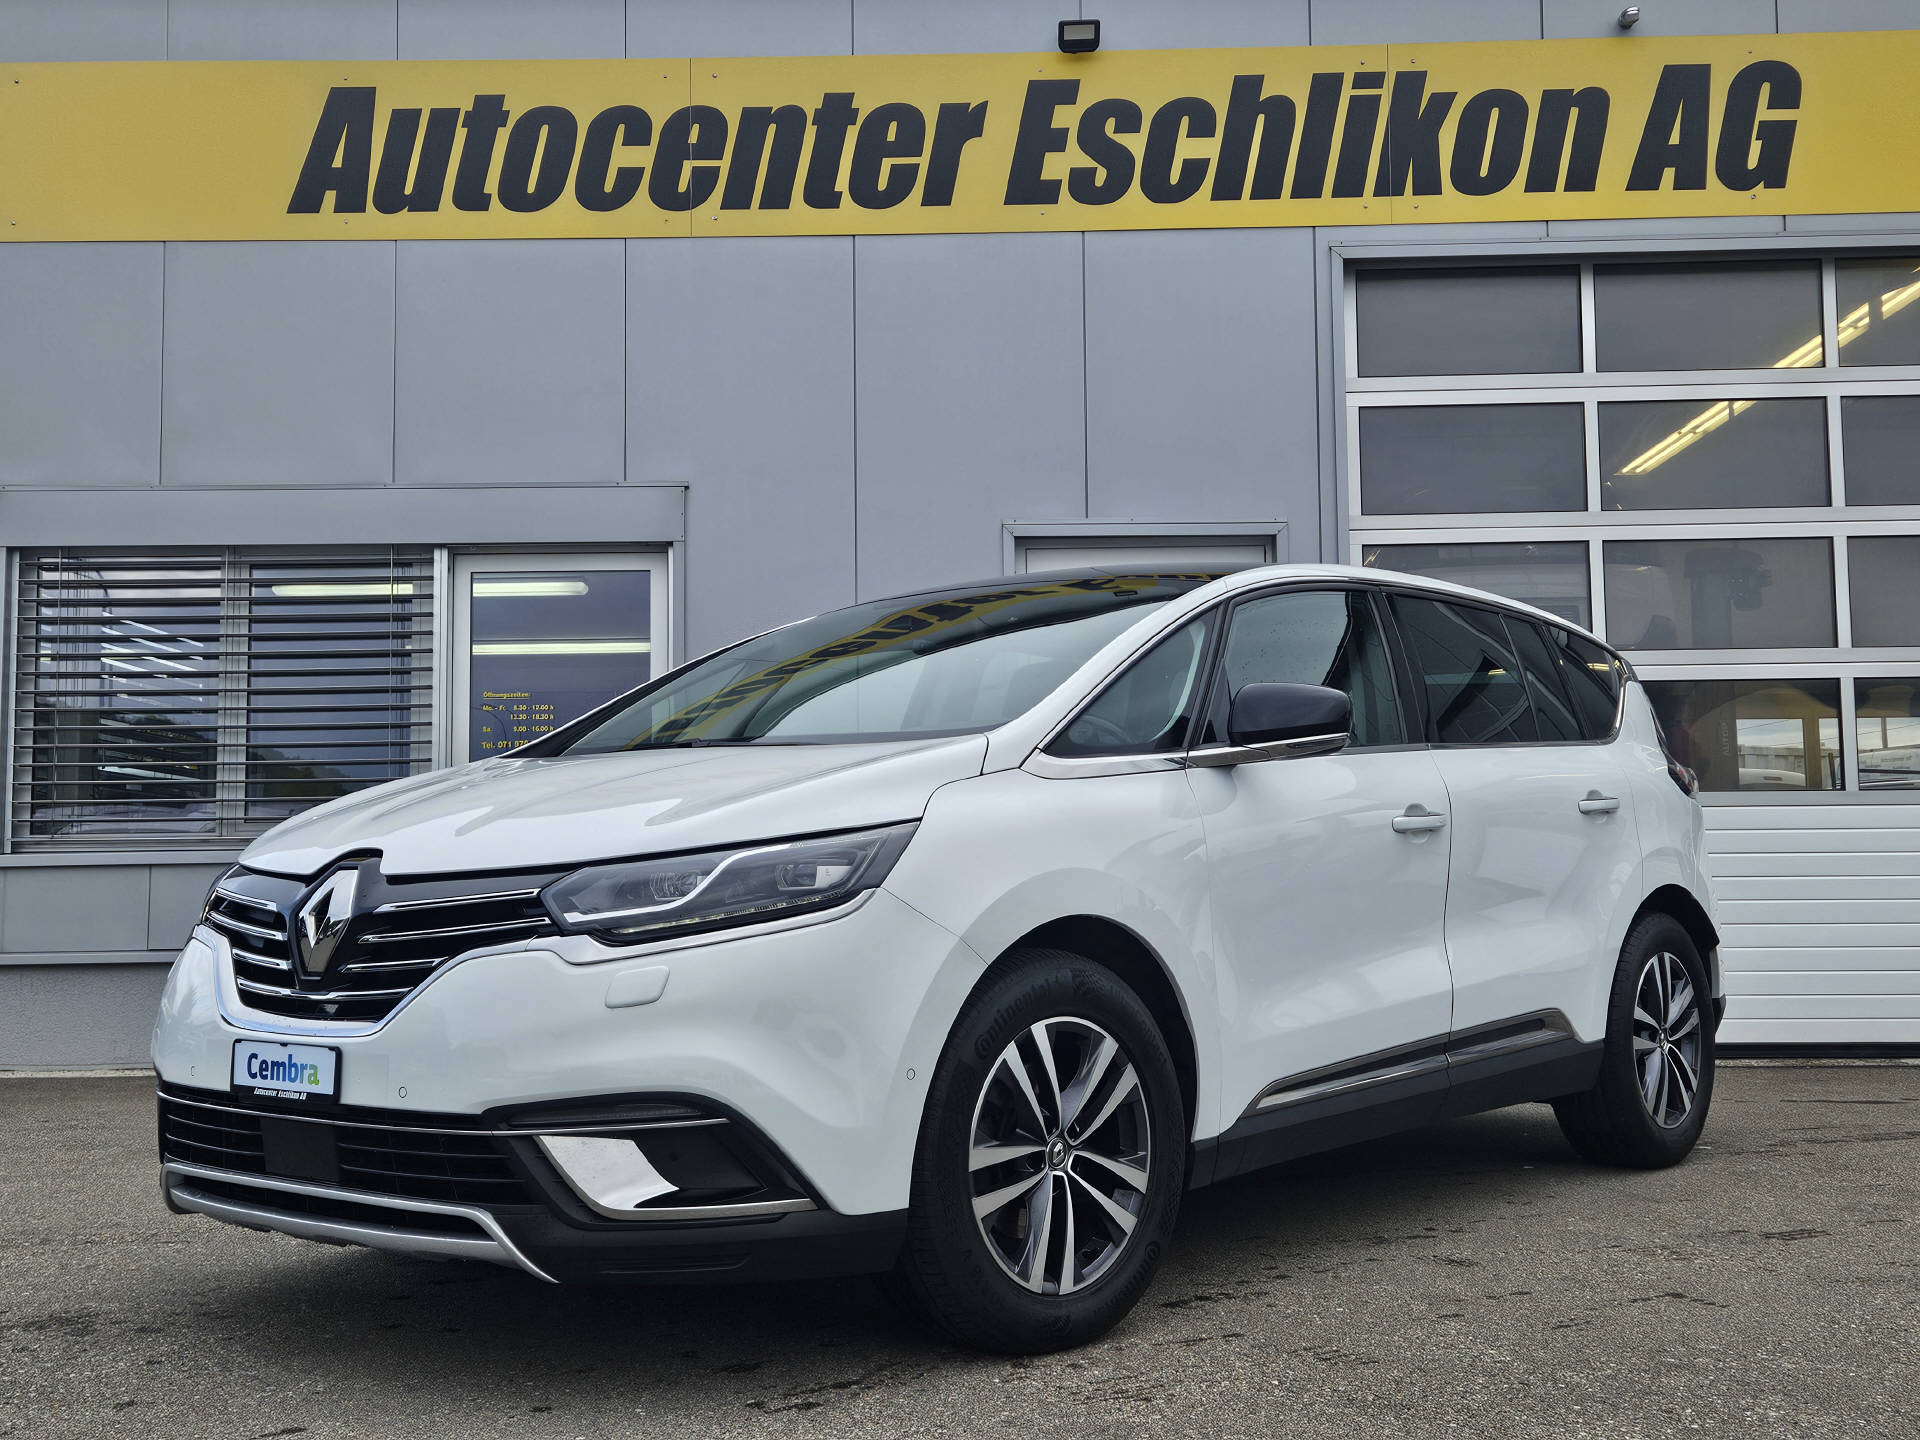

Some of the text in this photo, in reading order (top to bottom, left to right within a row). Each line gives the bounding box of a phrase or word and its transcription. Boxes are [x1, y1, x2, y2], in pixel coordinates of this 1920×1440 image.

[287, 60, 1801, 214] Autocenter Eschlikon AG
[482, 741, 496, 749] Tel.
[497, 740, 512, 748] 071
[247, 1052, 320, 1086] Cembra
